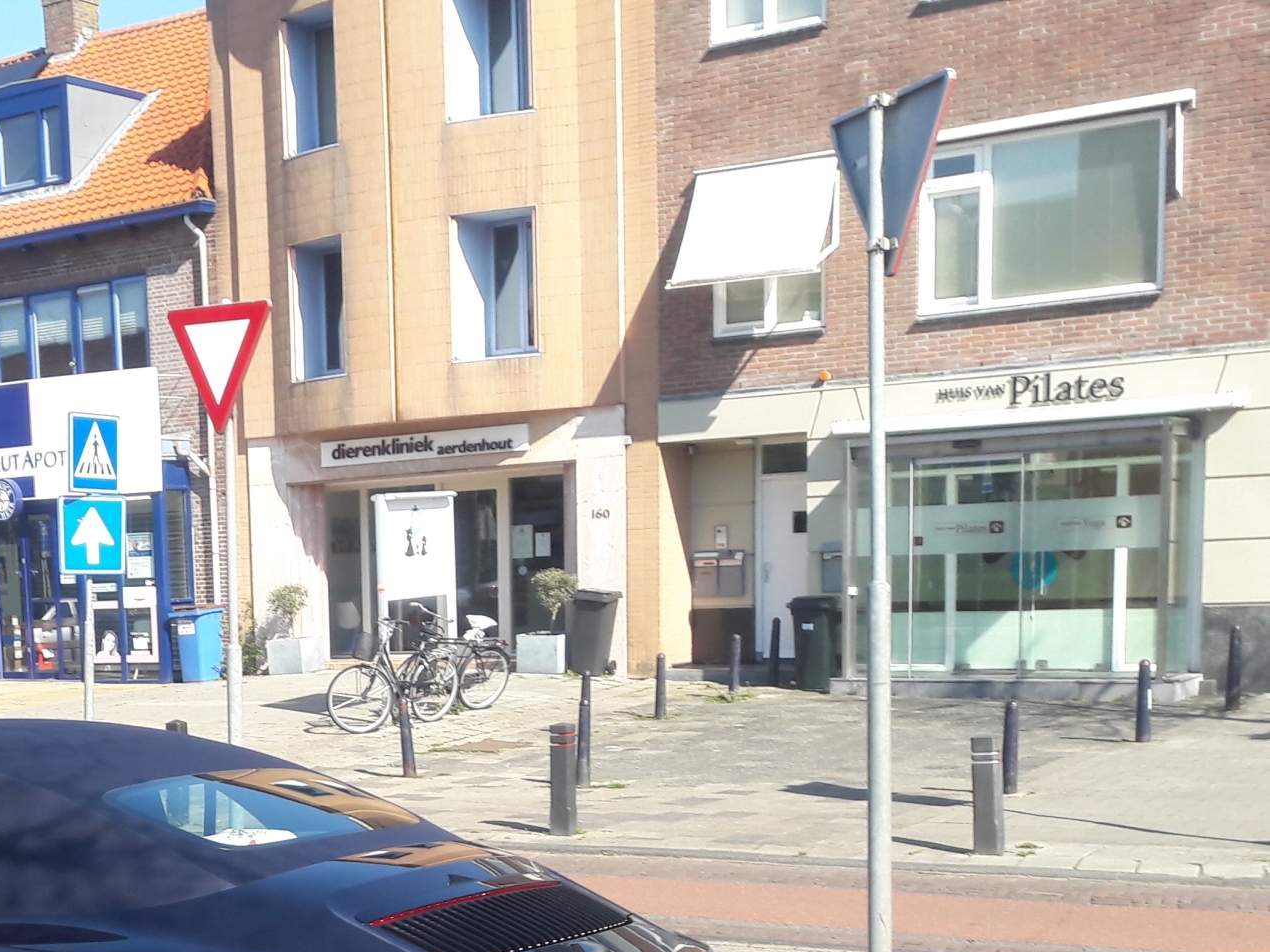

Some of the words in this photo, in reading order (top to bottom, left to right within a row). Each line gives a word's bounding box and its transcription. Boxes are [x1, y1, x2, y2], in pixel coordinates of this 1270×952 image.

[936, 386, 972, 402] HUIS
[976, 383, 1006, 400] VAN
[1008, 373, 1125, 406] Pilates
[332, 436, 434, 460] dierenkliniek
[437, 437, 513, 456] aerdenhout
[591, 509, 610, 519] 160
